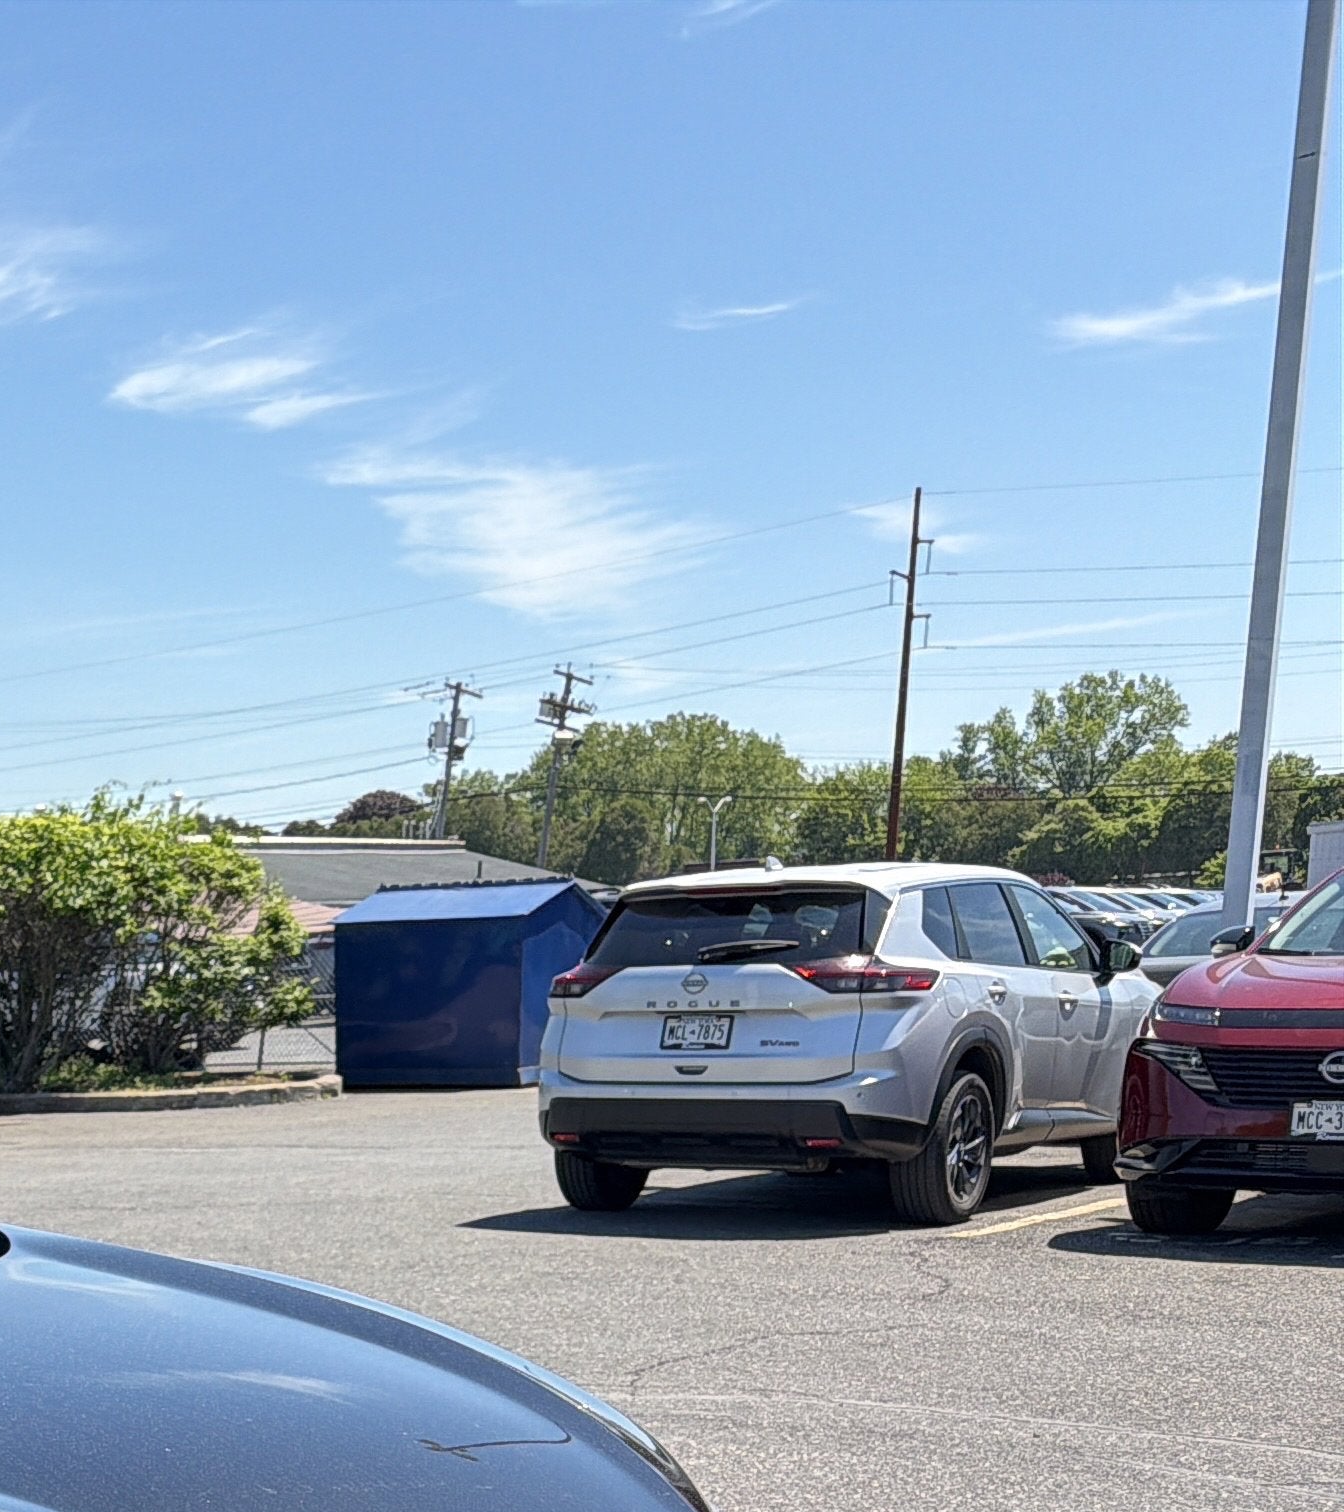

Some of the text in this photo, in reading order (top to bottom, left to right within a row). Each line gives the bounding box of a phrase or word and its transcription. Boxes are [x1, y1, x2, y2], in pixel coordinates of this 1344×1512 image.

[647, 1000, 740, 1008] ROGUE
[667, 1024, 725, 1041] MCL 7875
[1297, 1111, 1323, 1130] MCC
